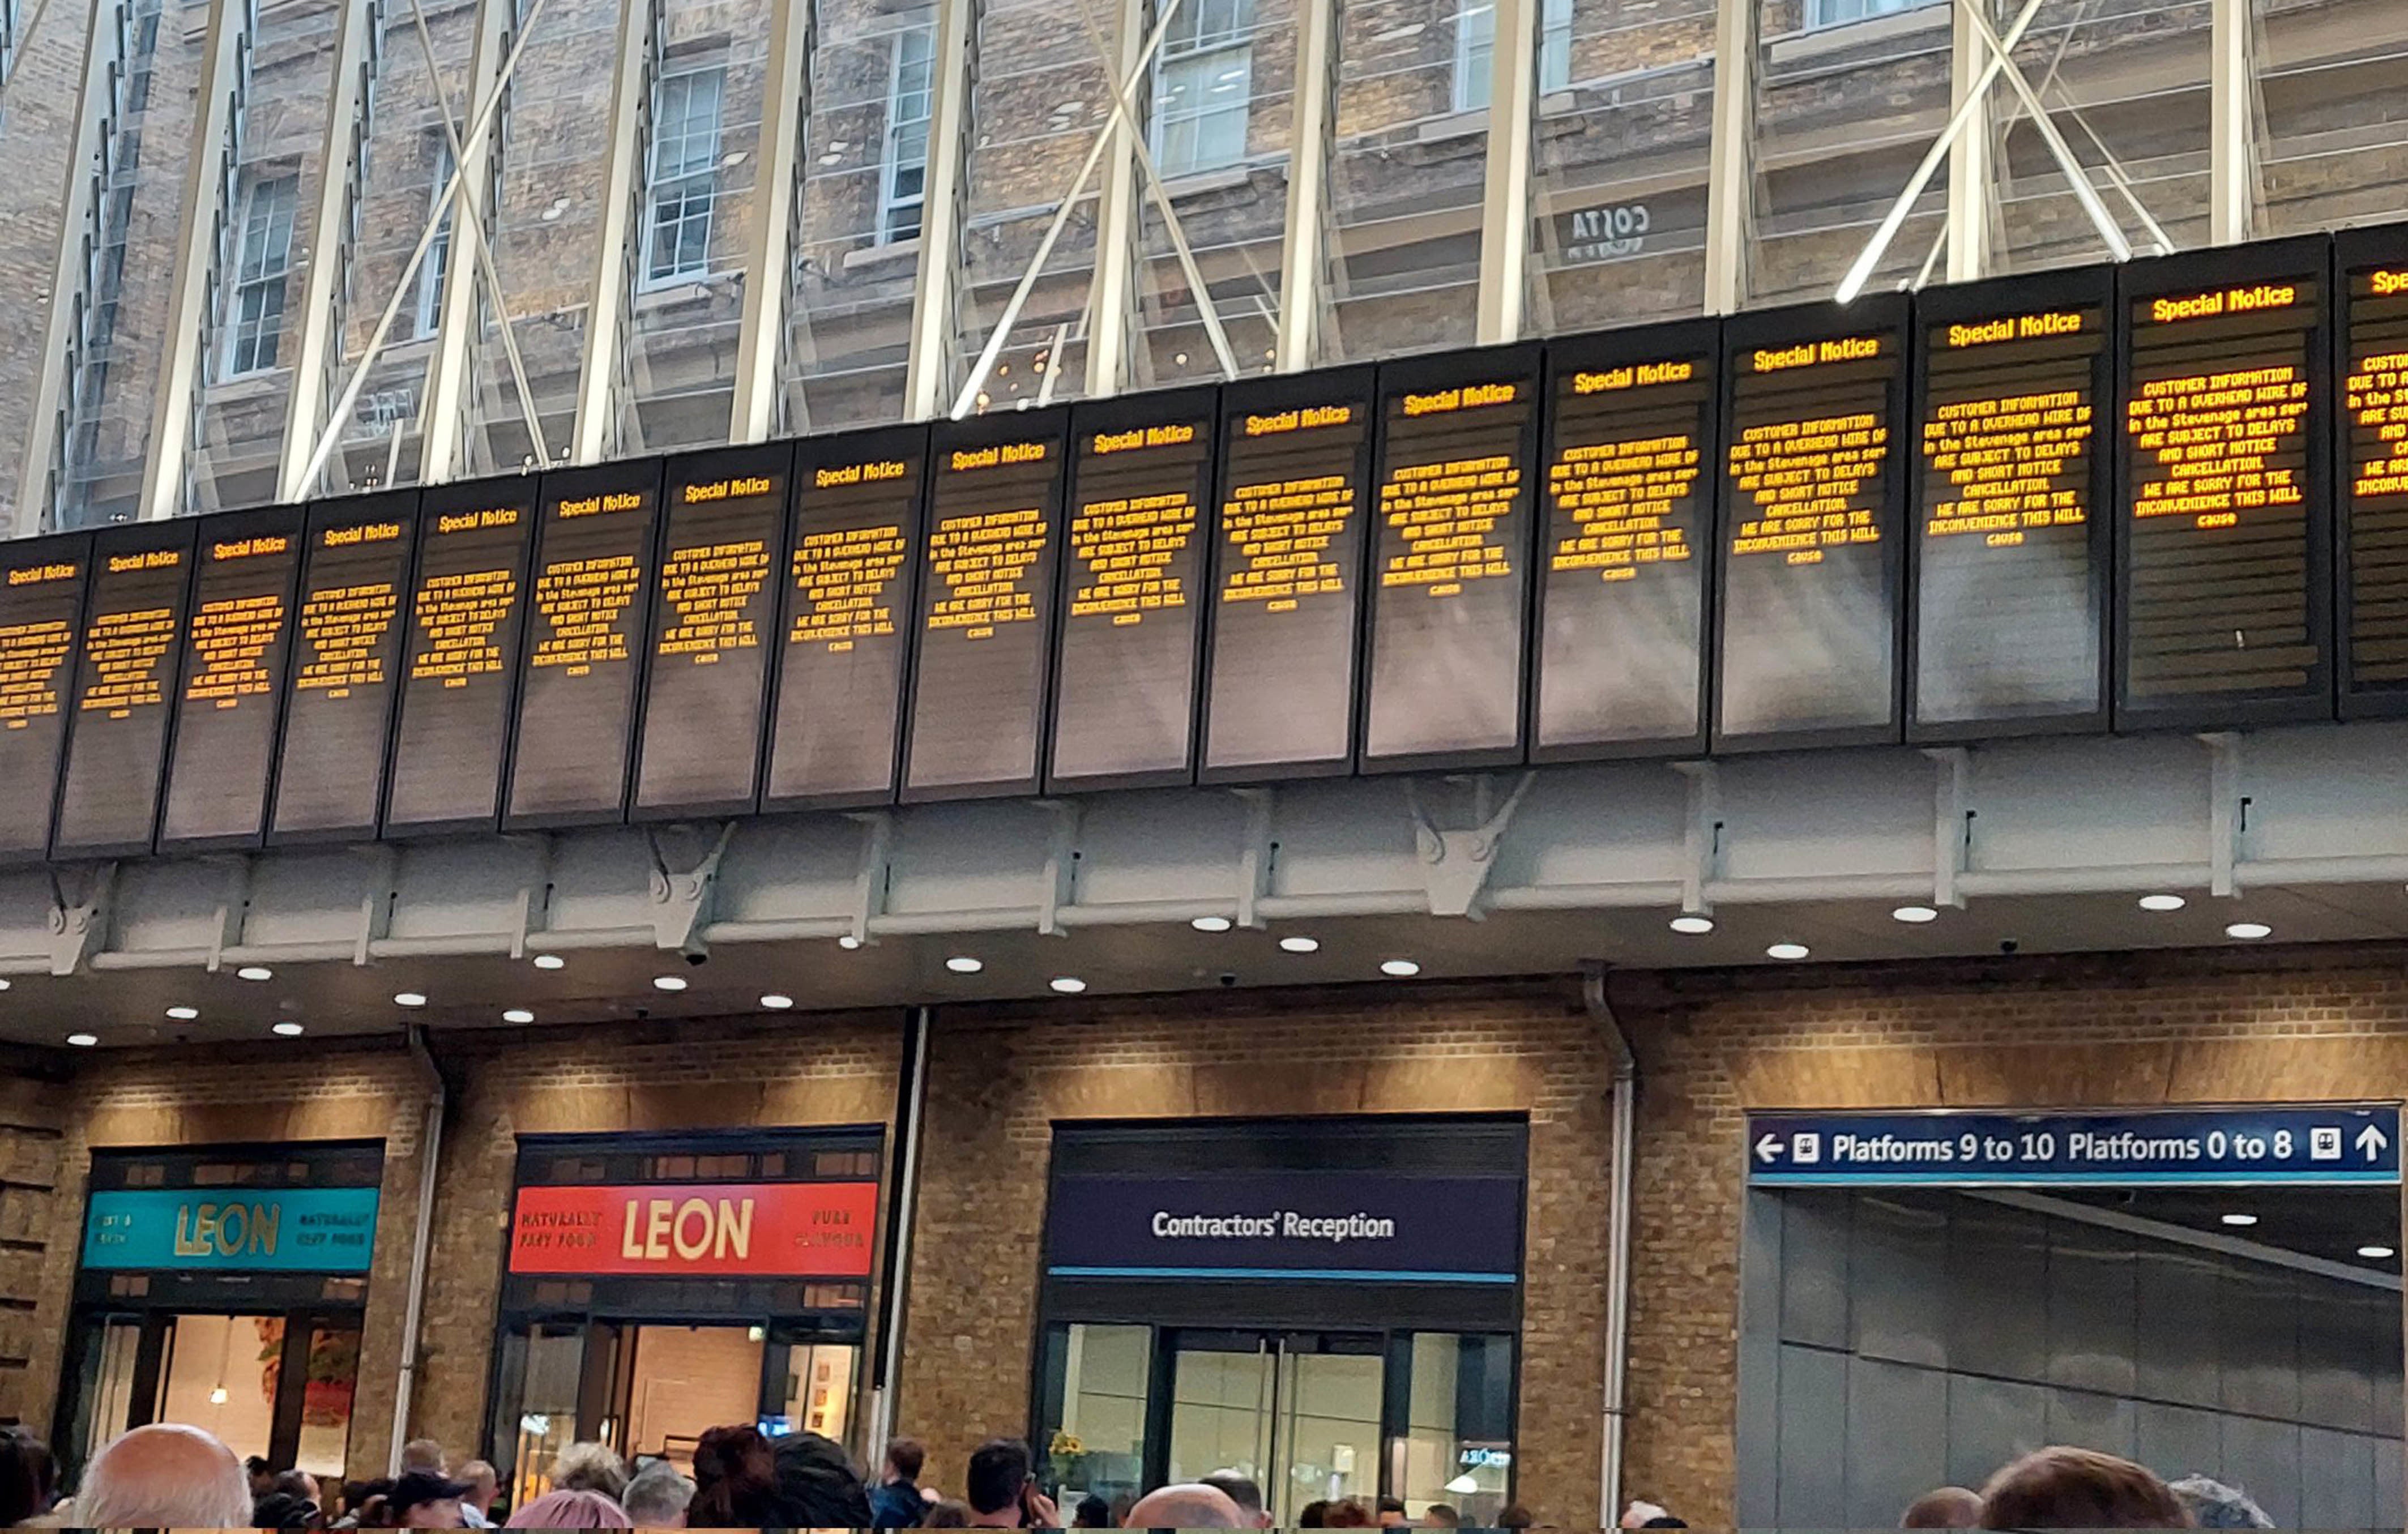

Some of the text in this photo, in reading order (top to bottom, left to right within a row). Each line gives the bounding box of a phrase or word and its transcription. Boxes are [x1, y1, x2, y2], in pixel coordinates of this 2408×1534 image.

[2153, 286, 2294, 322] Special Notice
[1949, 313, 2081, 347] Special Notice
[1754, 338, 1878, 371] Special Notice
[1575, 362, 1691, 393] Special Notice
[2143, 367, 2293, 398] CUSTOMER INFORMATION
[2348, 374, 2373, 391] DUE
[2377, 372, 2397, 388] TO
[1404, 384, 1515, 415] Special Notice
[2129, 399, 2154, 416] DUE
[2156, 398, 2175, 413] TO
[2177, 396, 2188, 411] A
[2191, 388, 2253, 409] OVERHEAD
[2255, 384, 2288, 403] WIRE
[2348, 394, 2362, 409] in
[2364, 391, 2391, 407] the
[1246, 408, 1350, 435] Special Notice
[2128, 418, 2142, 433] in
[2145, 416, 2170, 431] the
[2172, 409, 2242, 428] Stevenage
[2244, 405, 2277, 421] area
[2359, 408, 2387, 425] ARE
[1095, 426, 1193, 453] Special Notice
[2140, 418, 2295, 448] ARE SUBJECT TO DELAYS
[2379, 424, 2407, 440] AND
[952, 444, 1045, 470] Special Notice
[2158, 437, 2277, 463] AND SHORT NOTICE
[817, 463, 904, 486] Special Notice
[2363, 460, 2385, 477] WE
[685, 478, 770, 502] Special Notice
[2142, 469, 2291, 498] WE ARE SORRY FOR THE
[560, 495, 641, 516] Special Notice
[2135, 486, 2302, 517] INCONVENIENCE THIS WILL
[439, 511, 517, 532] Special Notice
[2197, 512, 2237, 528] cause
[326, 525, 399, 546] Special Notice
[1833, 1133, 2055, 1162] Platforms 9 to 10
[2068, 1130, 2292, 1160] Platforms 0 to 8
[173, 1203, 281, 1257] LEON
[622, 1198, 754, 1260] LEON
[1282, 1212, 1395, 1242] Reception
